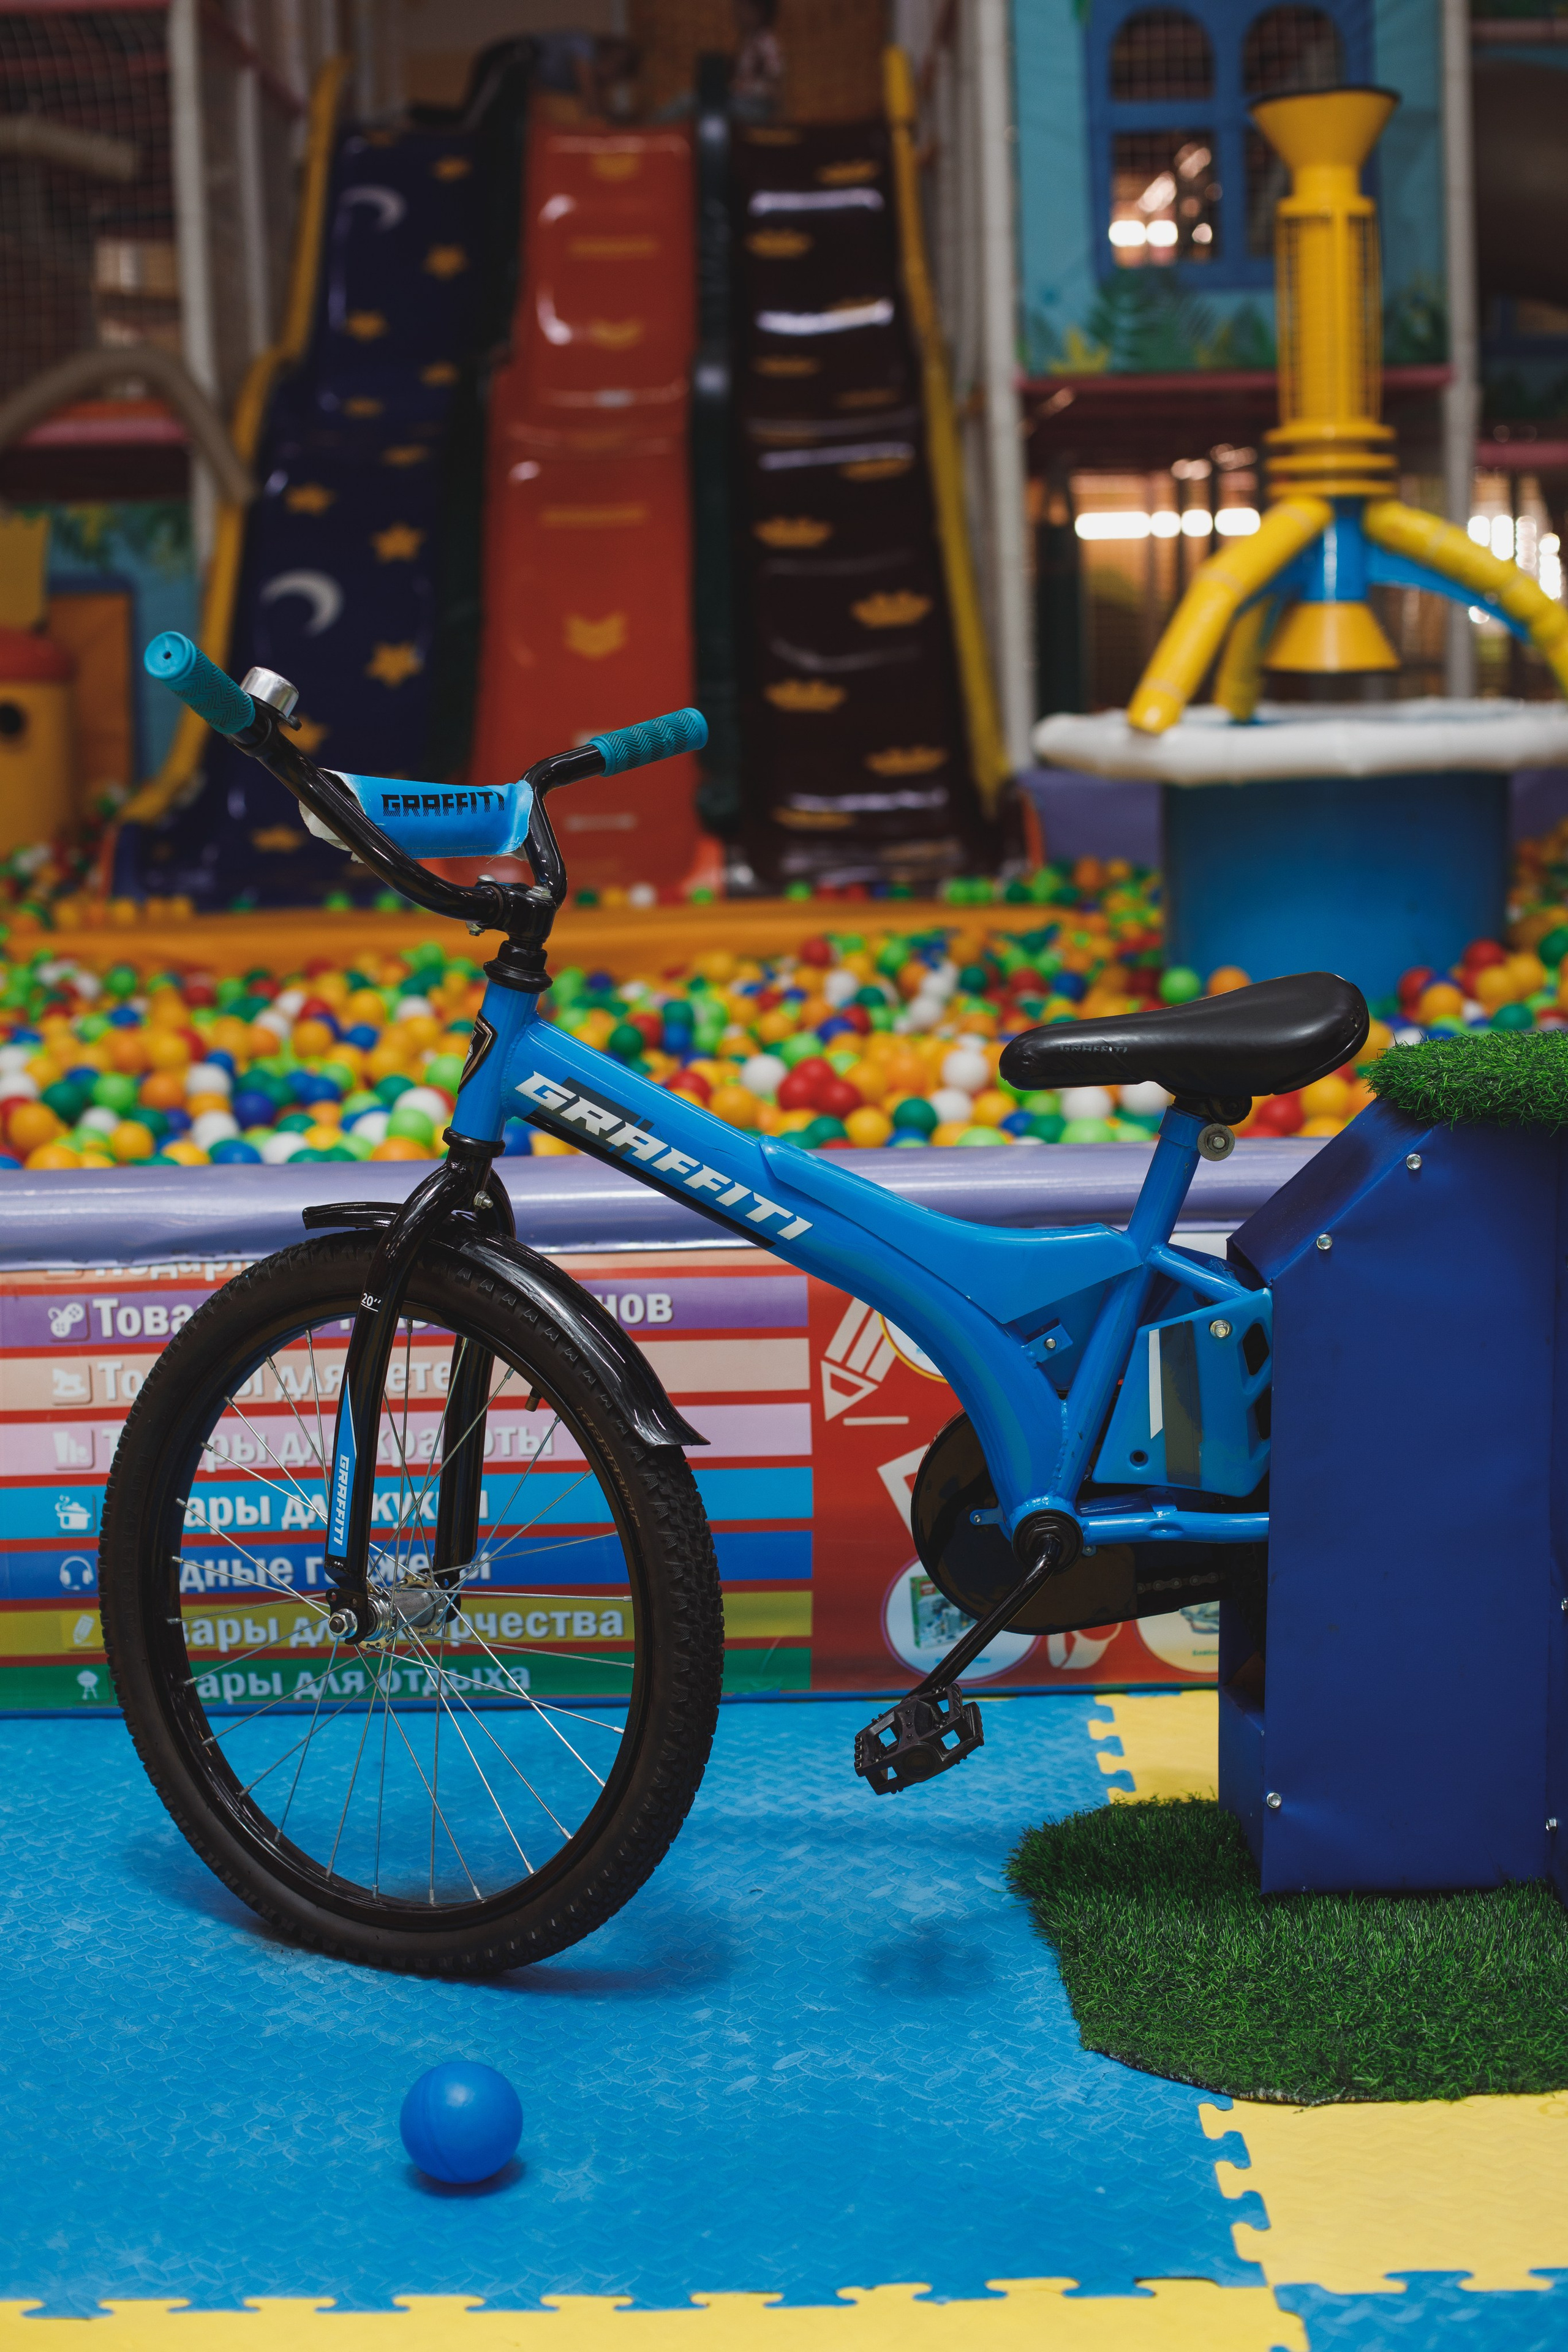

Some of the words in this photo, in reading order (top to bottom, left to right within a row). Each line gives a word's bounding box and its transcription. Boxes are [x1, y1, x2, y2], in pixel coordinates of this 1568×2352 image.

[381, 791, 505, 817] GRAFFITI
[514, 1071, 813, 1240] GRAFFITI
[92, 1298, 201, 1338] Това
[386, 1361, 451, 1393] ете
[184, 1494, 271, 1536] ары
[281, 1493, 330, 1531] дл
[334, 1453, 350, 1547] GRAFFITI
[179, 1556, 294, 1593] дные
[196, 1671, 283, 1705] ары
[293, 1670, 365, 1700] для
[377, 1665, 532, 1696] отдыха
